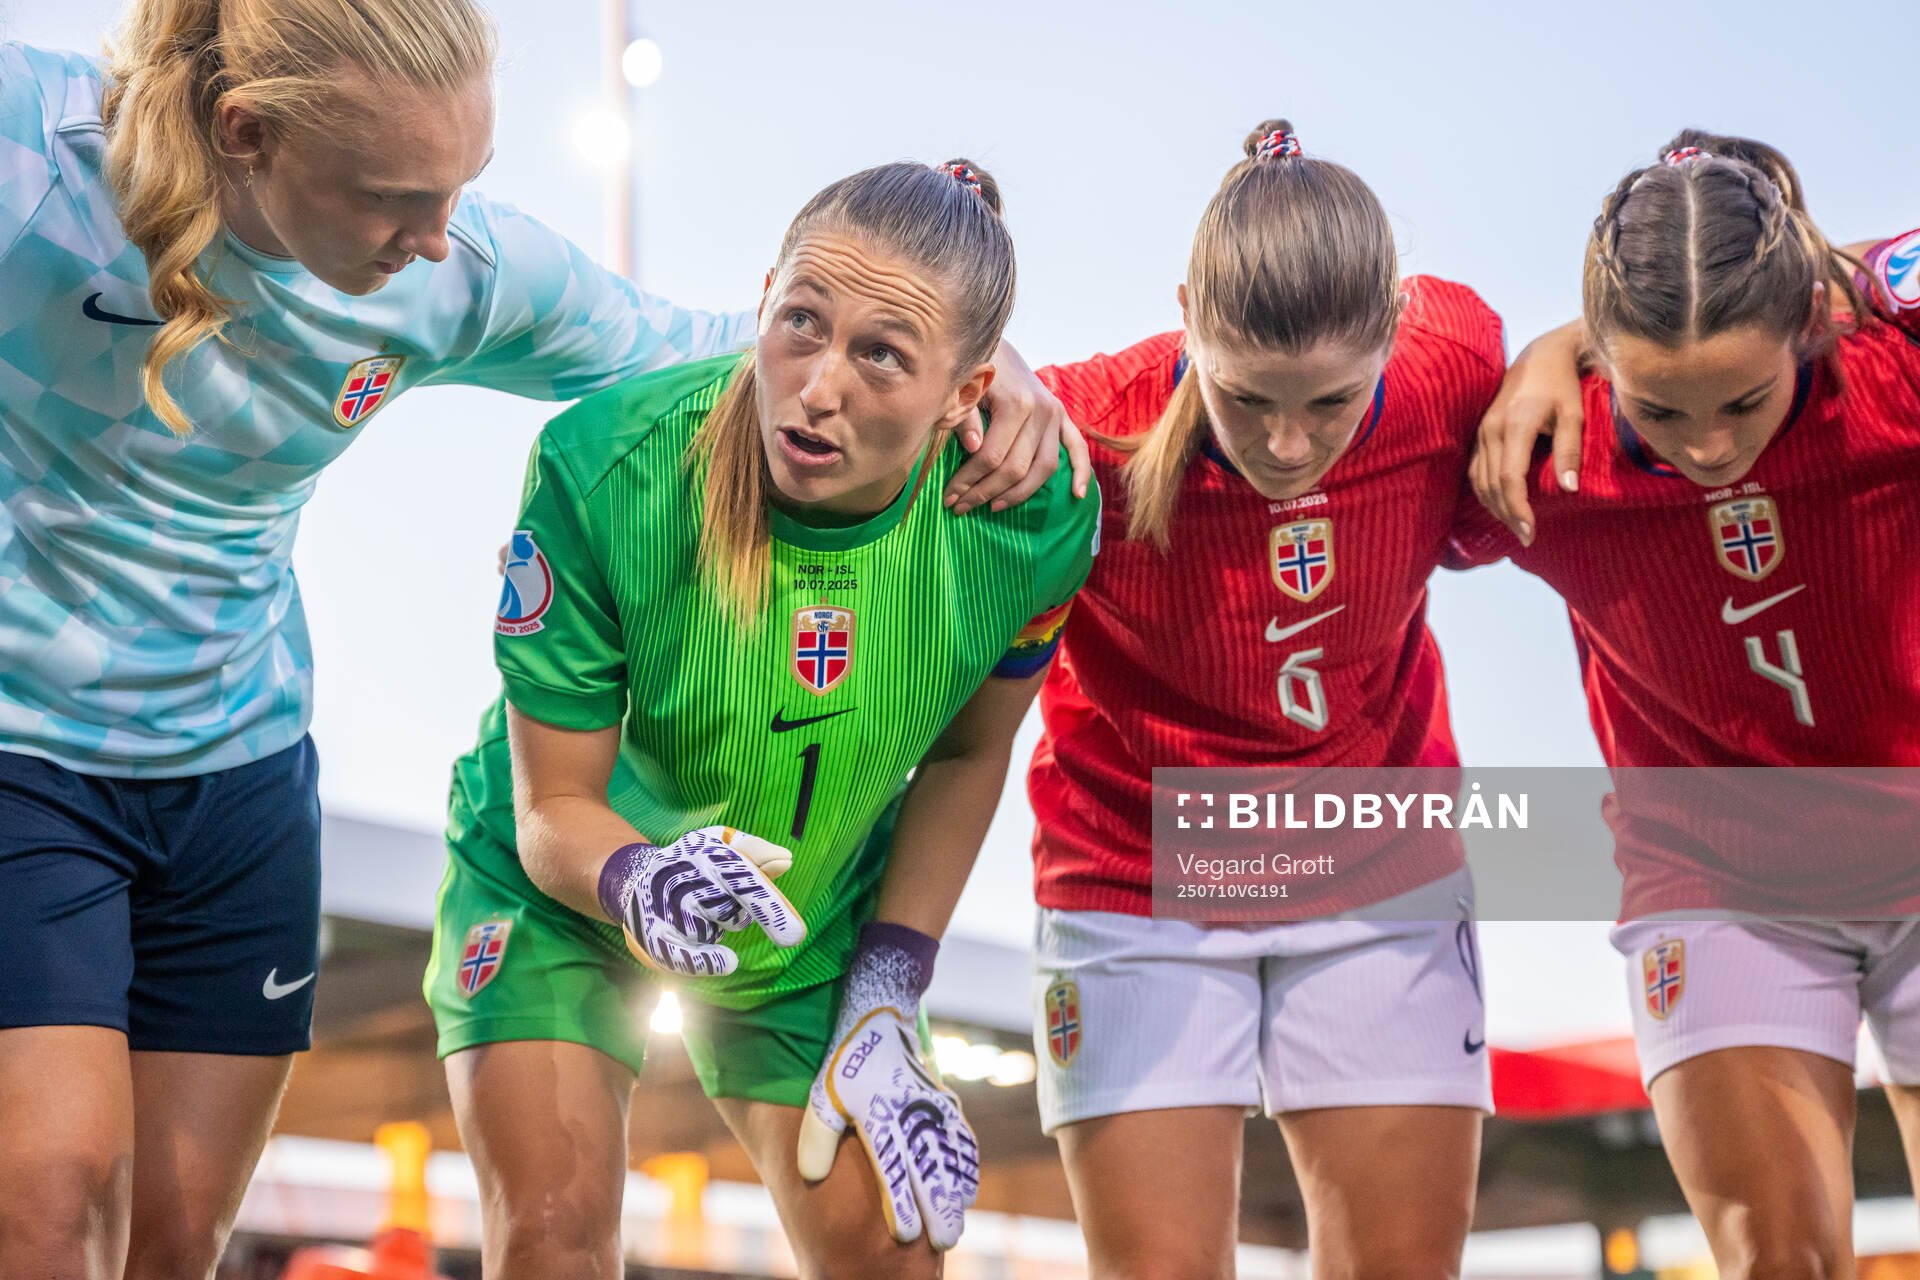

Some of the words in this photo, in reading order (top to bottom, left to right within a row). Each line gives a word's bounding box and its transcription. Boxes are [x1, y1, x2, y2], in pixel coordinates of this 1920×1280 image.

[794, 579, 858, 590] 10.07.2025
[798, 564, 824, 574] NOR
[836, 564, 855, 575] ISL
[519, 621, 539, 633] 2025
[814, 611, 833, 619] NORGE
[1277, 647, 1329, 733] 6
[1744, 629, 1816, 727] 4
[790, 742, 821, 842] 1
[841, 1030, 883, 1080] PRED
